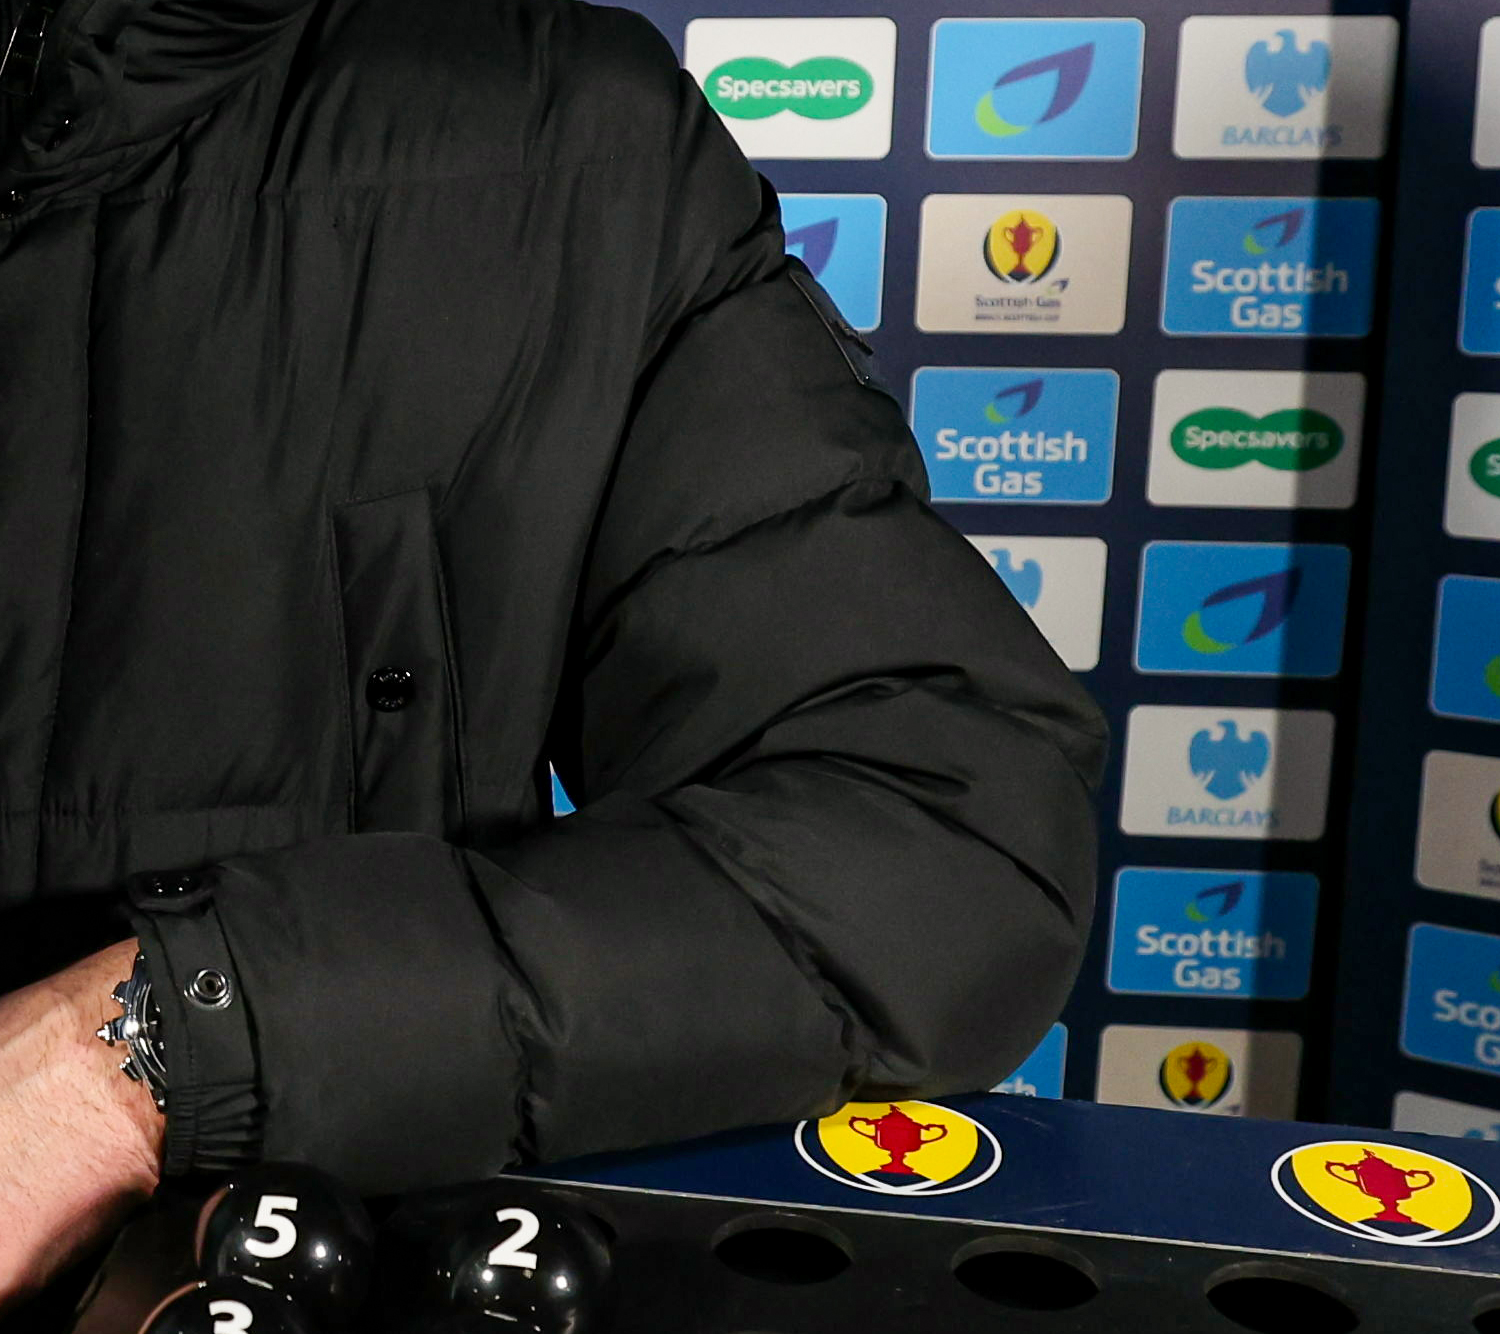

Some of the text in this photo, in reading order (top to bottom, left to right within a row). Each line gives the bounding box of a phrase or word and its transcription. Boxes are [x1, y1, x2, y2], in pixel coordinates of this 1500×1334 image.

[716, 76, 861, 102] Specsavers
[1221, 123, 1343, 148] BARCLAYS
[1190, 260, 1349, 295] Scottish
[1229, 297, 1302, 330] Gas
[935, 426, 1088, 462] Scottish
[1183, 424, 1330, 452] Specsavers
[972, 463, 1043, 498] Gas
[1167, 804, 1279, 829] BARCLAYS
[1135, 924, 1286, 960] Scottish
[1172, 959, 1241, 991] Gas
[244, 1195, 300, 1260] 5
[487, 1208, 540, 1270] 2
